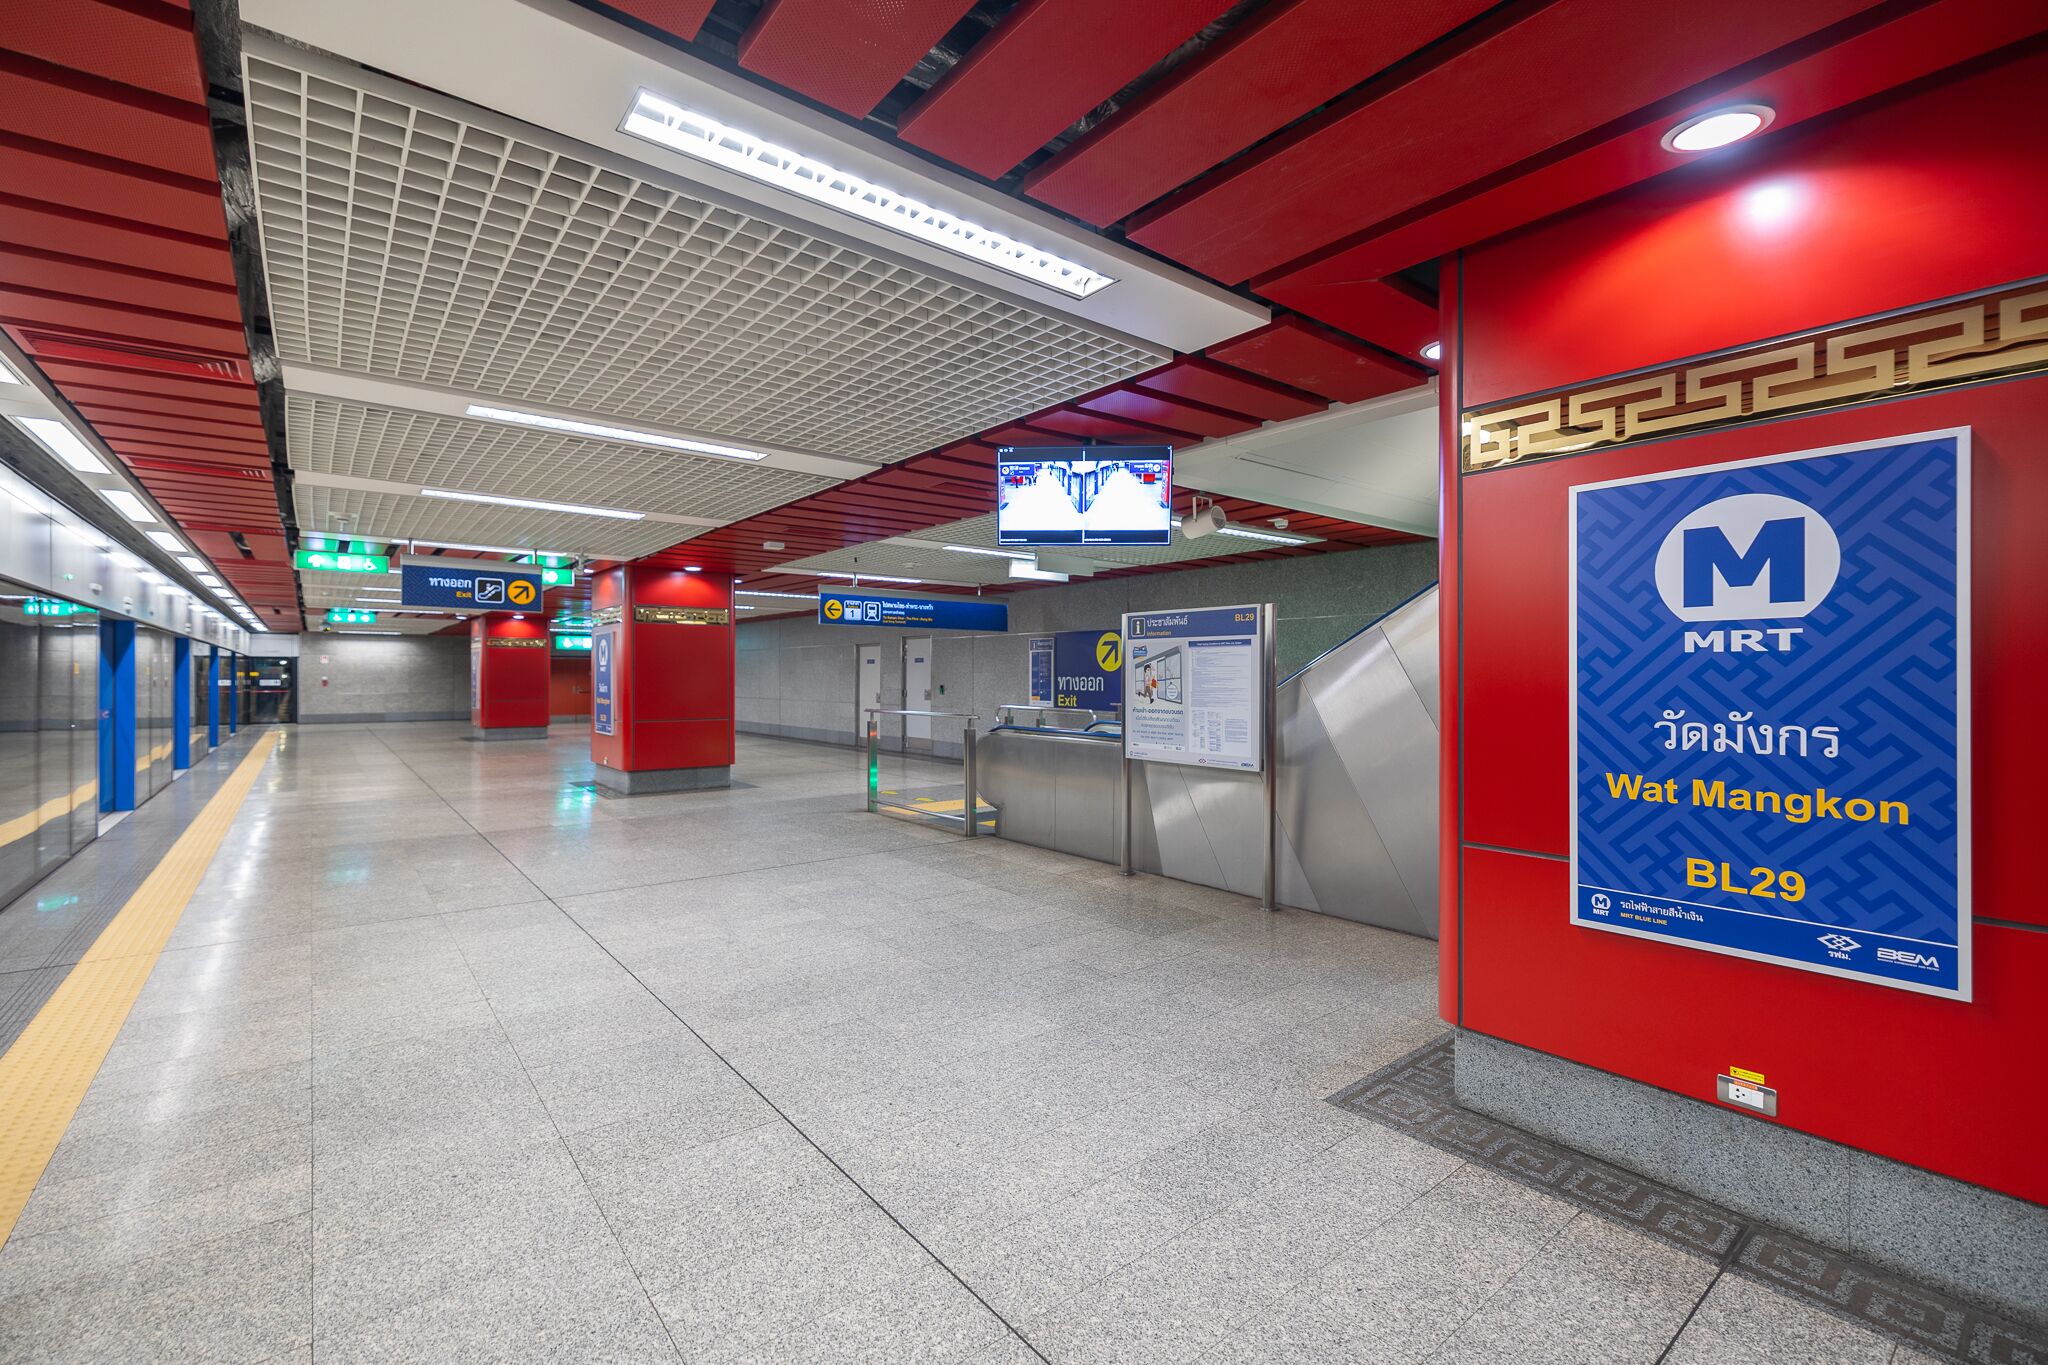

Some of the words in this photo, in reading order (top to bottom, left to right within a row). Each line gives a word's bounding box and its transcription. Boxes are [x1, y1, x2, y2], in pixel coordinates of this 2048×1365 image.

[1683, 516, 1805, 608] M
[429, 577, 472, 588] ทางออก
[850, 609, 855, 618] 1
[1147, 615, 1188, 627] ประชาสัมพันธ์
[1234, 613, 1254, 622] BL29
[1684, 628, 1804, 653] MRT
[1057, 676, 1104, 691] ทางออก
[1057, 694, 1077, 707] Exit
[1654, 709, 1840, 758] วัดมังกร
[1605, 772, 1679, 804] Wat
[1691, 779, 1909, 825] Mangkon
[1686, 857, 1806, 902] BL29
[1593, 908, 1610, 916] MRT
[1620, 900, 1704, 922] รถไฟฟ้าสายสีน้ำเงิน
[1634, 914, 1652, 923] BLUE
[1877, 948, 1940, 968] BEM
